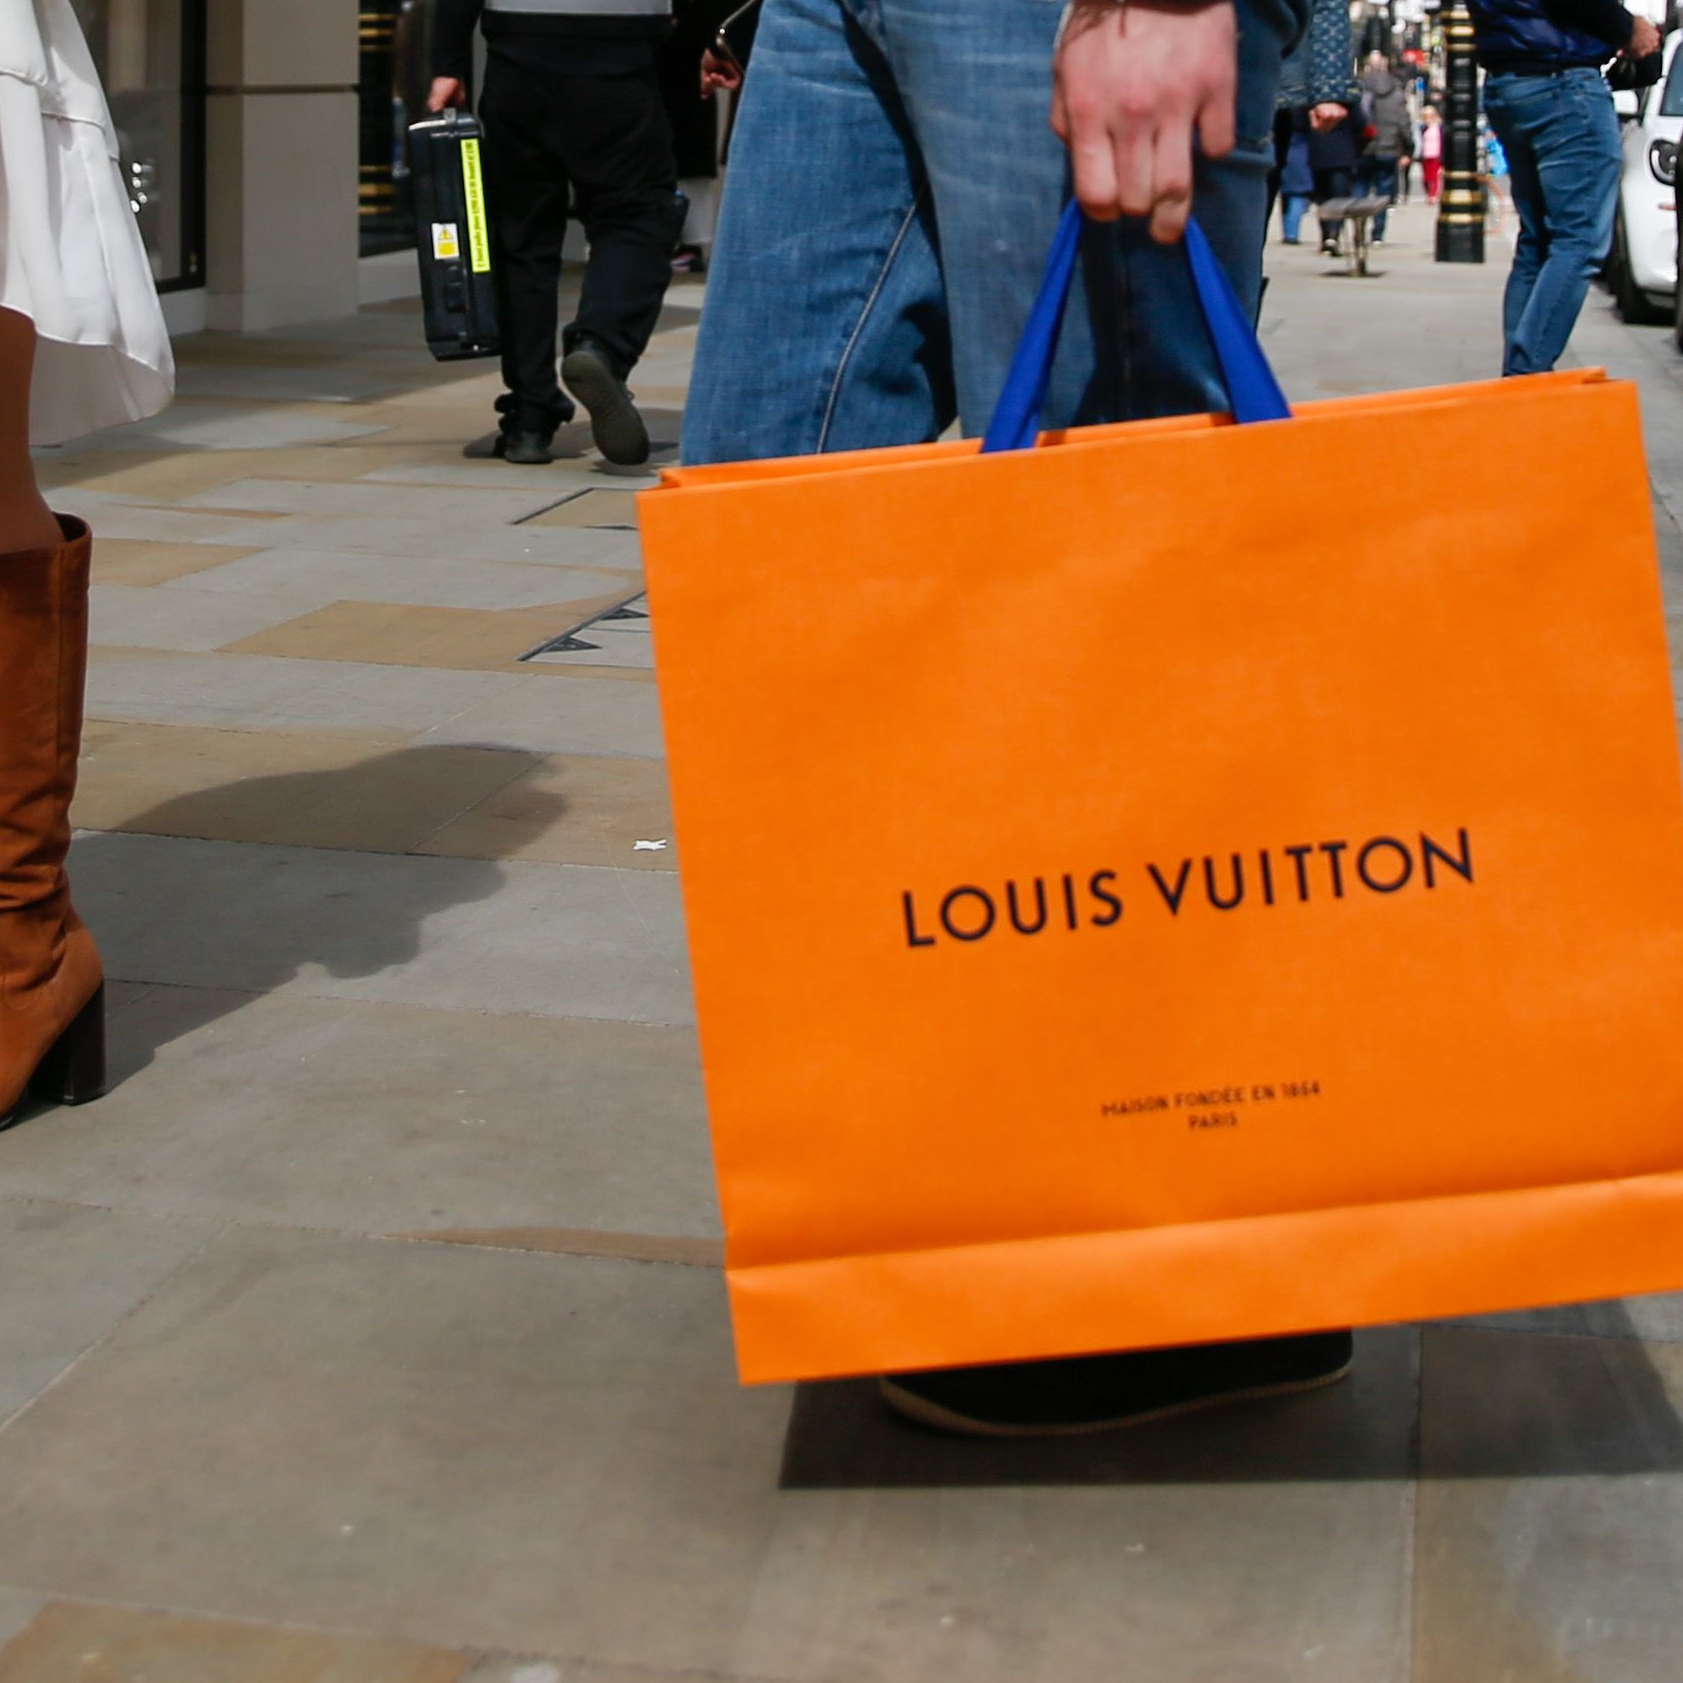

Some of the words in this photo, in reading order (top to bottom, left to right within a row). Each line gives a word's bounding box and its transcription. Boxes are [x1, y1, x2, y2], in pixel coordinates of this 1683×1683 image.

[902, 869, 1124, 949] LOUIS
[1146, 827, 1475, 916] VUITTON
[1101, 1096, 1169, 1116] MAISON
[1252, 1085, 1276, 1101] EN
[1188, 1112, 1238, 1129] PARIS
